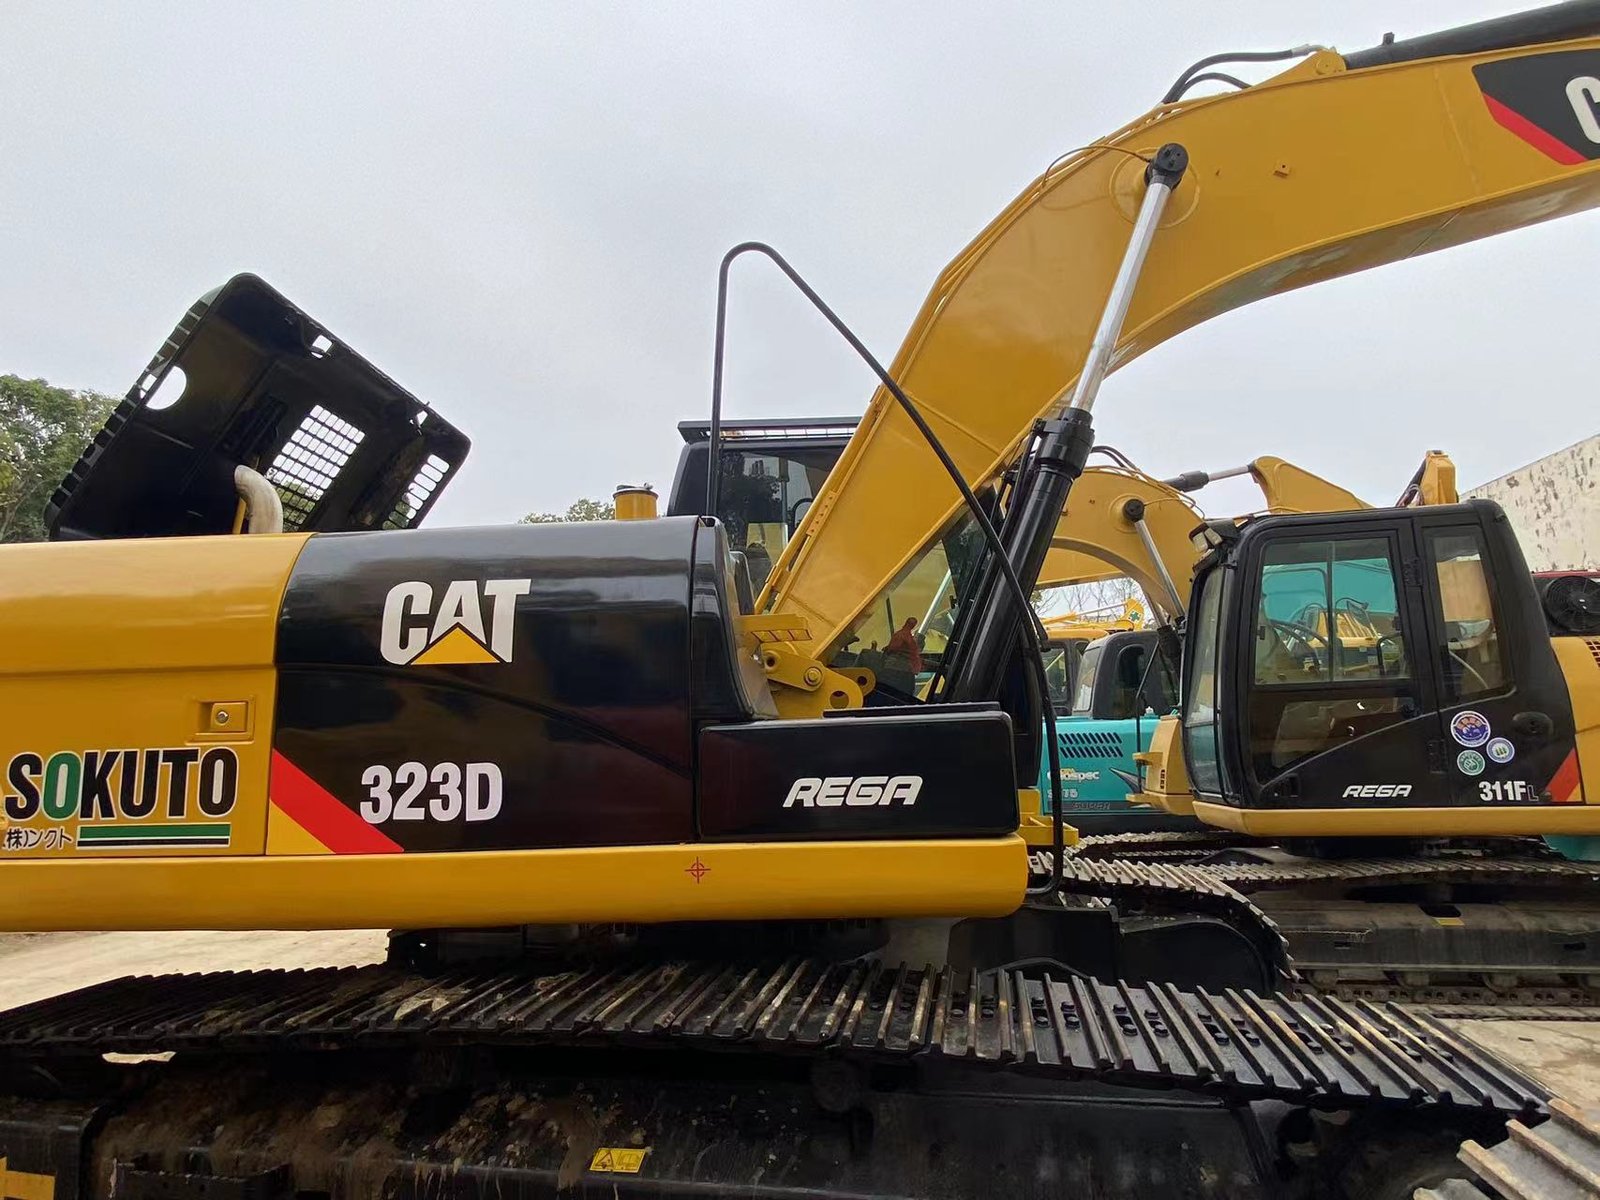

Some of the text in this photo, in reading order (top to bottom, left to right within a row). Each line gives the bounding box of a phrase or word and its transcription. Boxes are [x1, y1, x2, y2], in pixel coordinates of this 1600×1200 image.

[380, 579, 532, 666] CAT
[5, 746, 239, 821] SOKUTO
[360, 761, 503, 824] 323D
[782, 775, 924, 808] REGA
[1342, 784, 1413, 798] REGA
